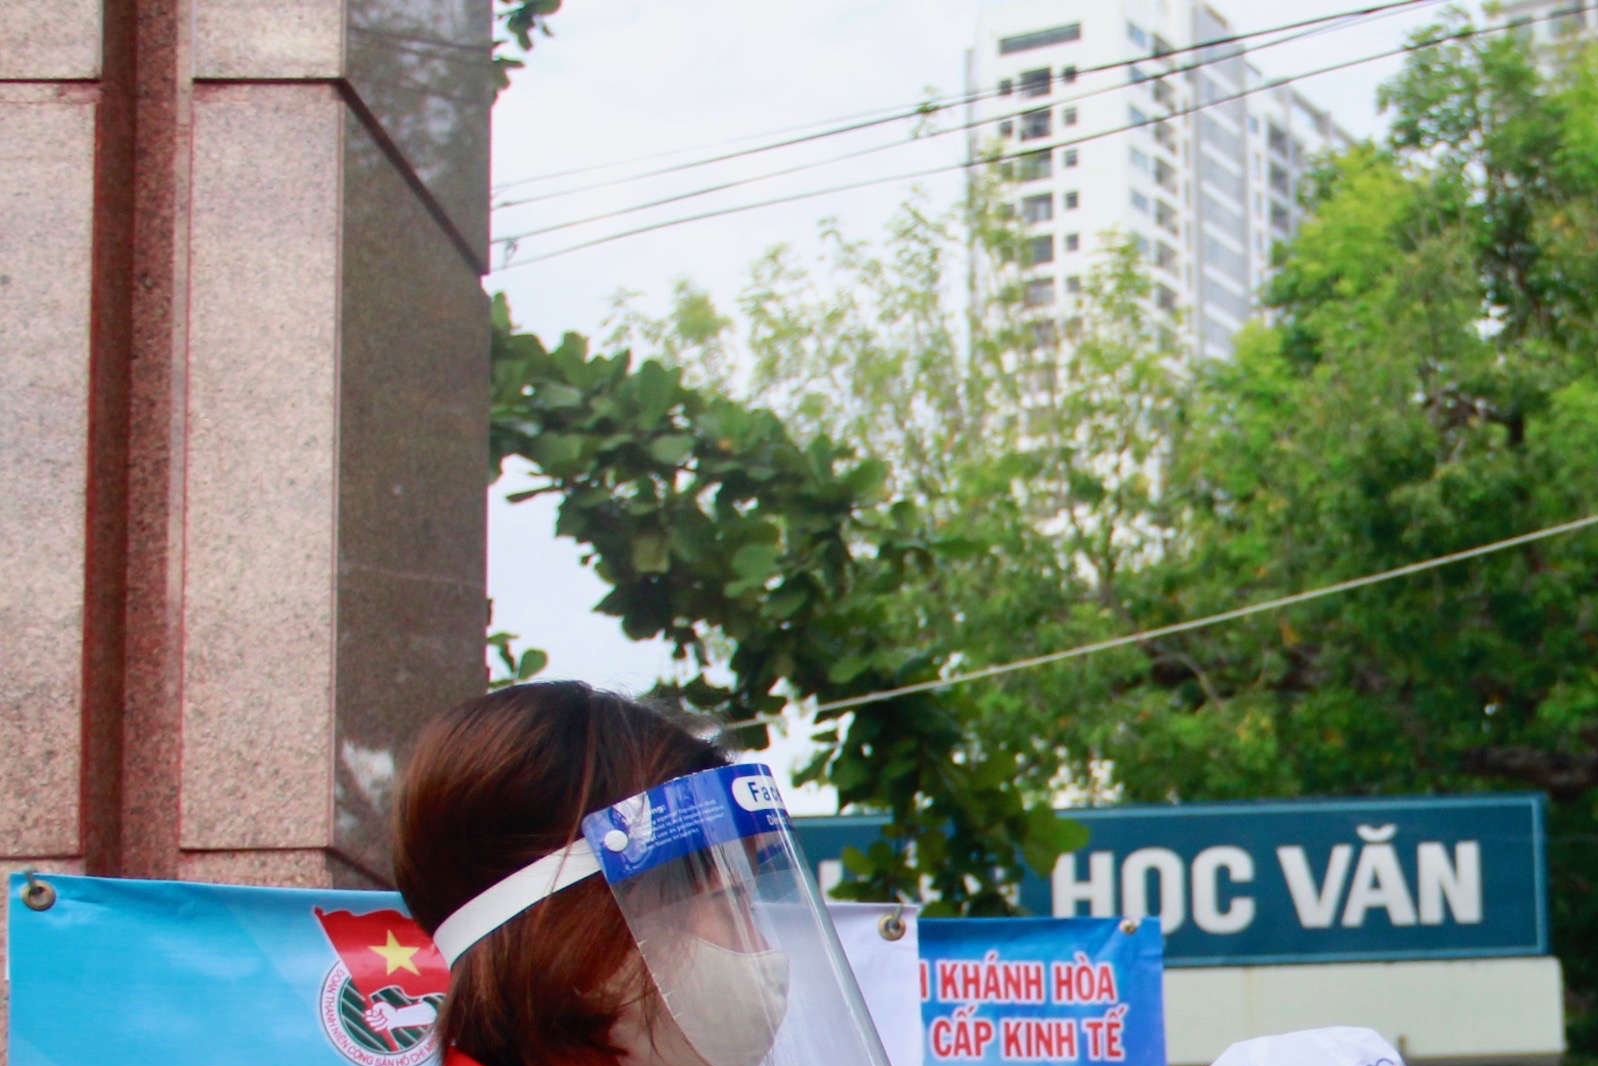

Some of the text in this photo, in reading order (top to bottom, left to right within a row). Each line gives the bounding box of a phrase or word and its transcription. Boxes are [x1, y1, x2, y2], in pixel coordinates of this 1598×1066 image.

[1276, 824, 1482, 928] VĂN
[940, 953, 1042, 999] KHÁNH
[1055, 954, 1115, 1001] HÒA
[933, 1005, 1126, 1057] CẤP KINH TẾ
